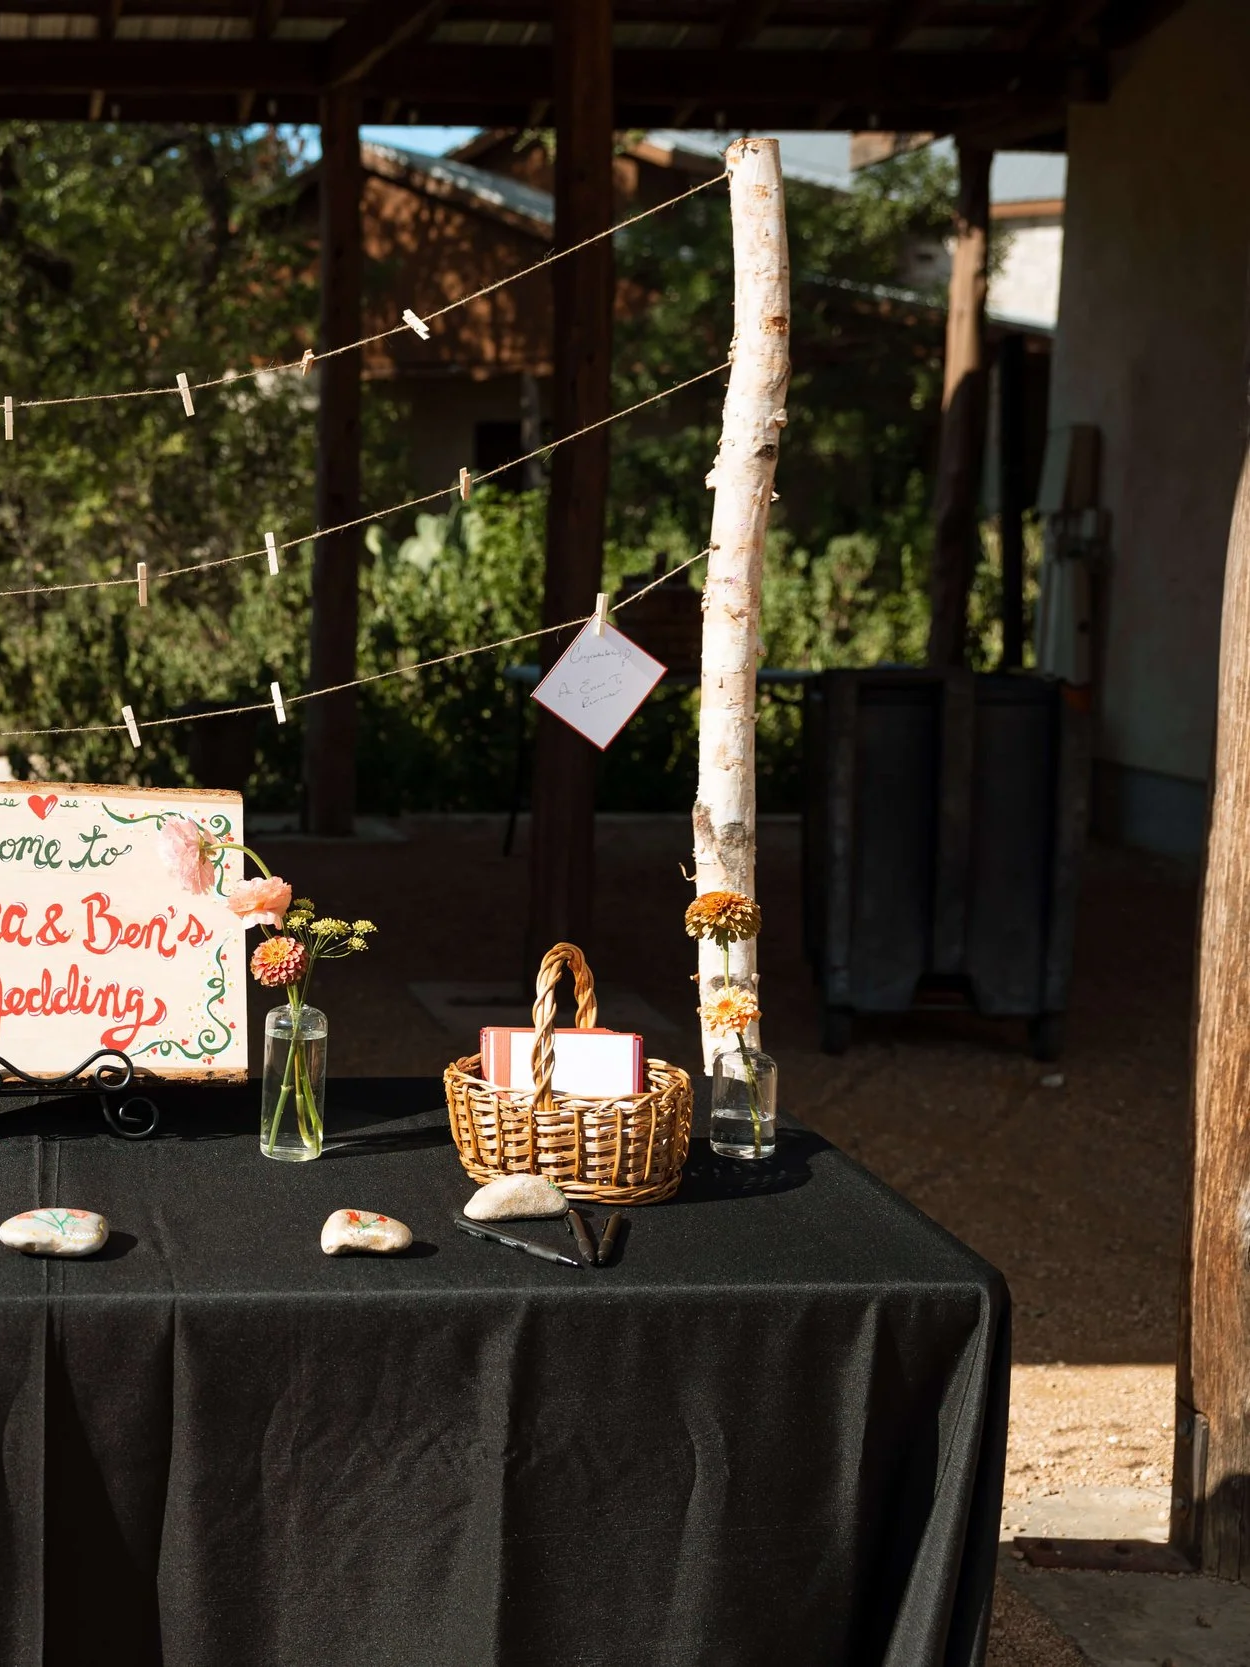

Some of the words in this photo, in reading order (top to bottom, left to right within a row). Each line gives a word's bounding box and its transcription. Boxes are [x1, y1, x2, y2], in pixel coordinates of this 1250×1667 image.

[69, 825, 133, 872] to
[35, 903, 72, 948] &
[81, 892, 213, 961] Ben's
